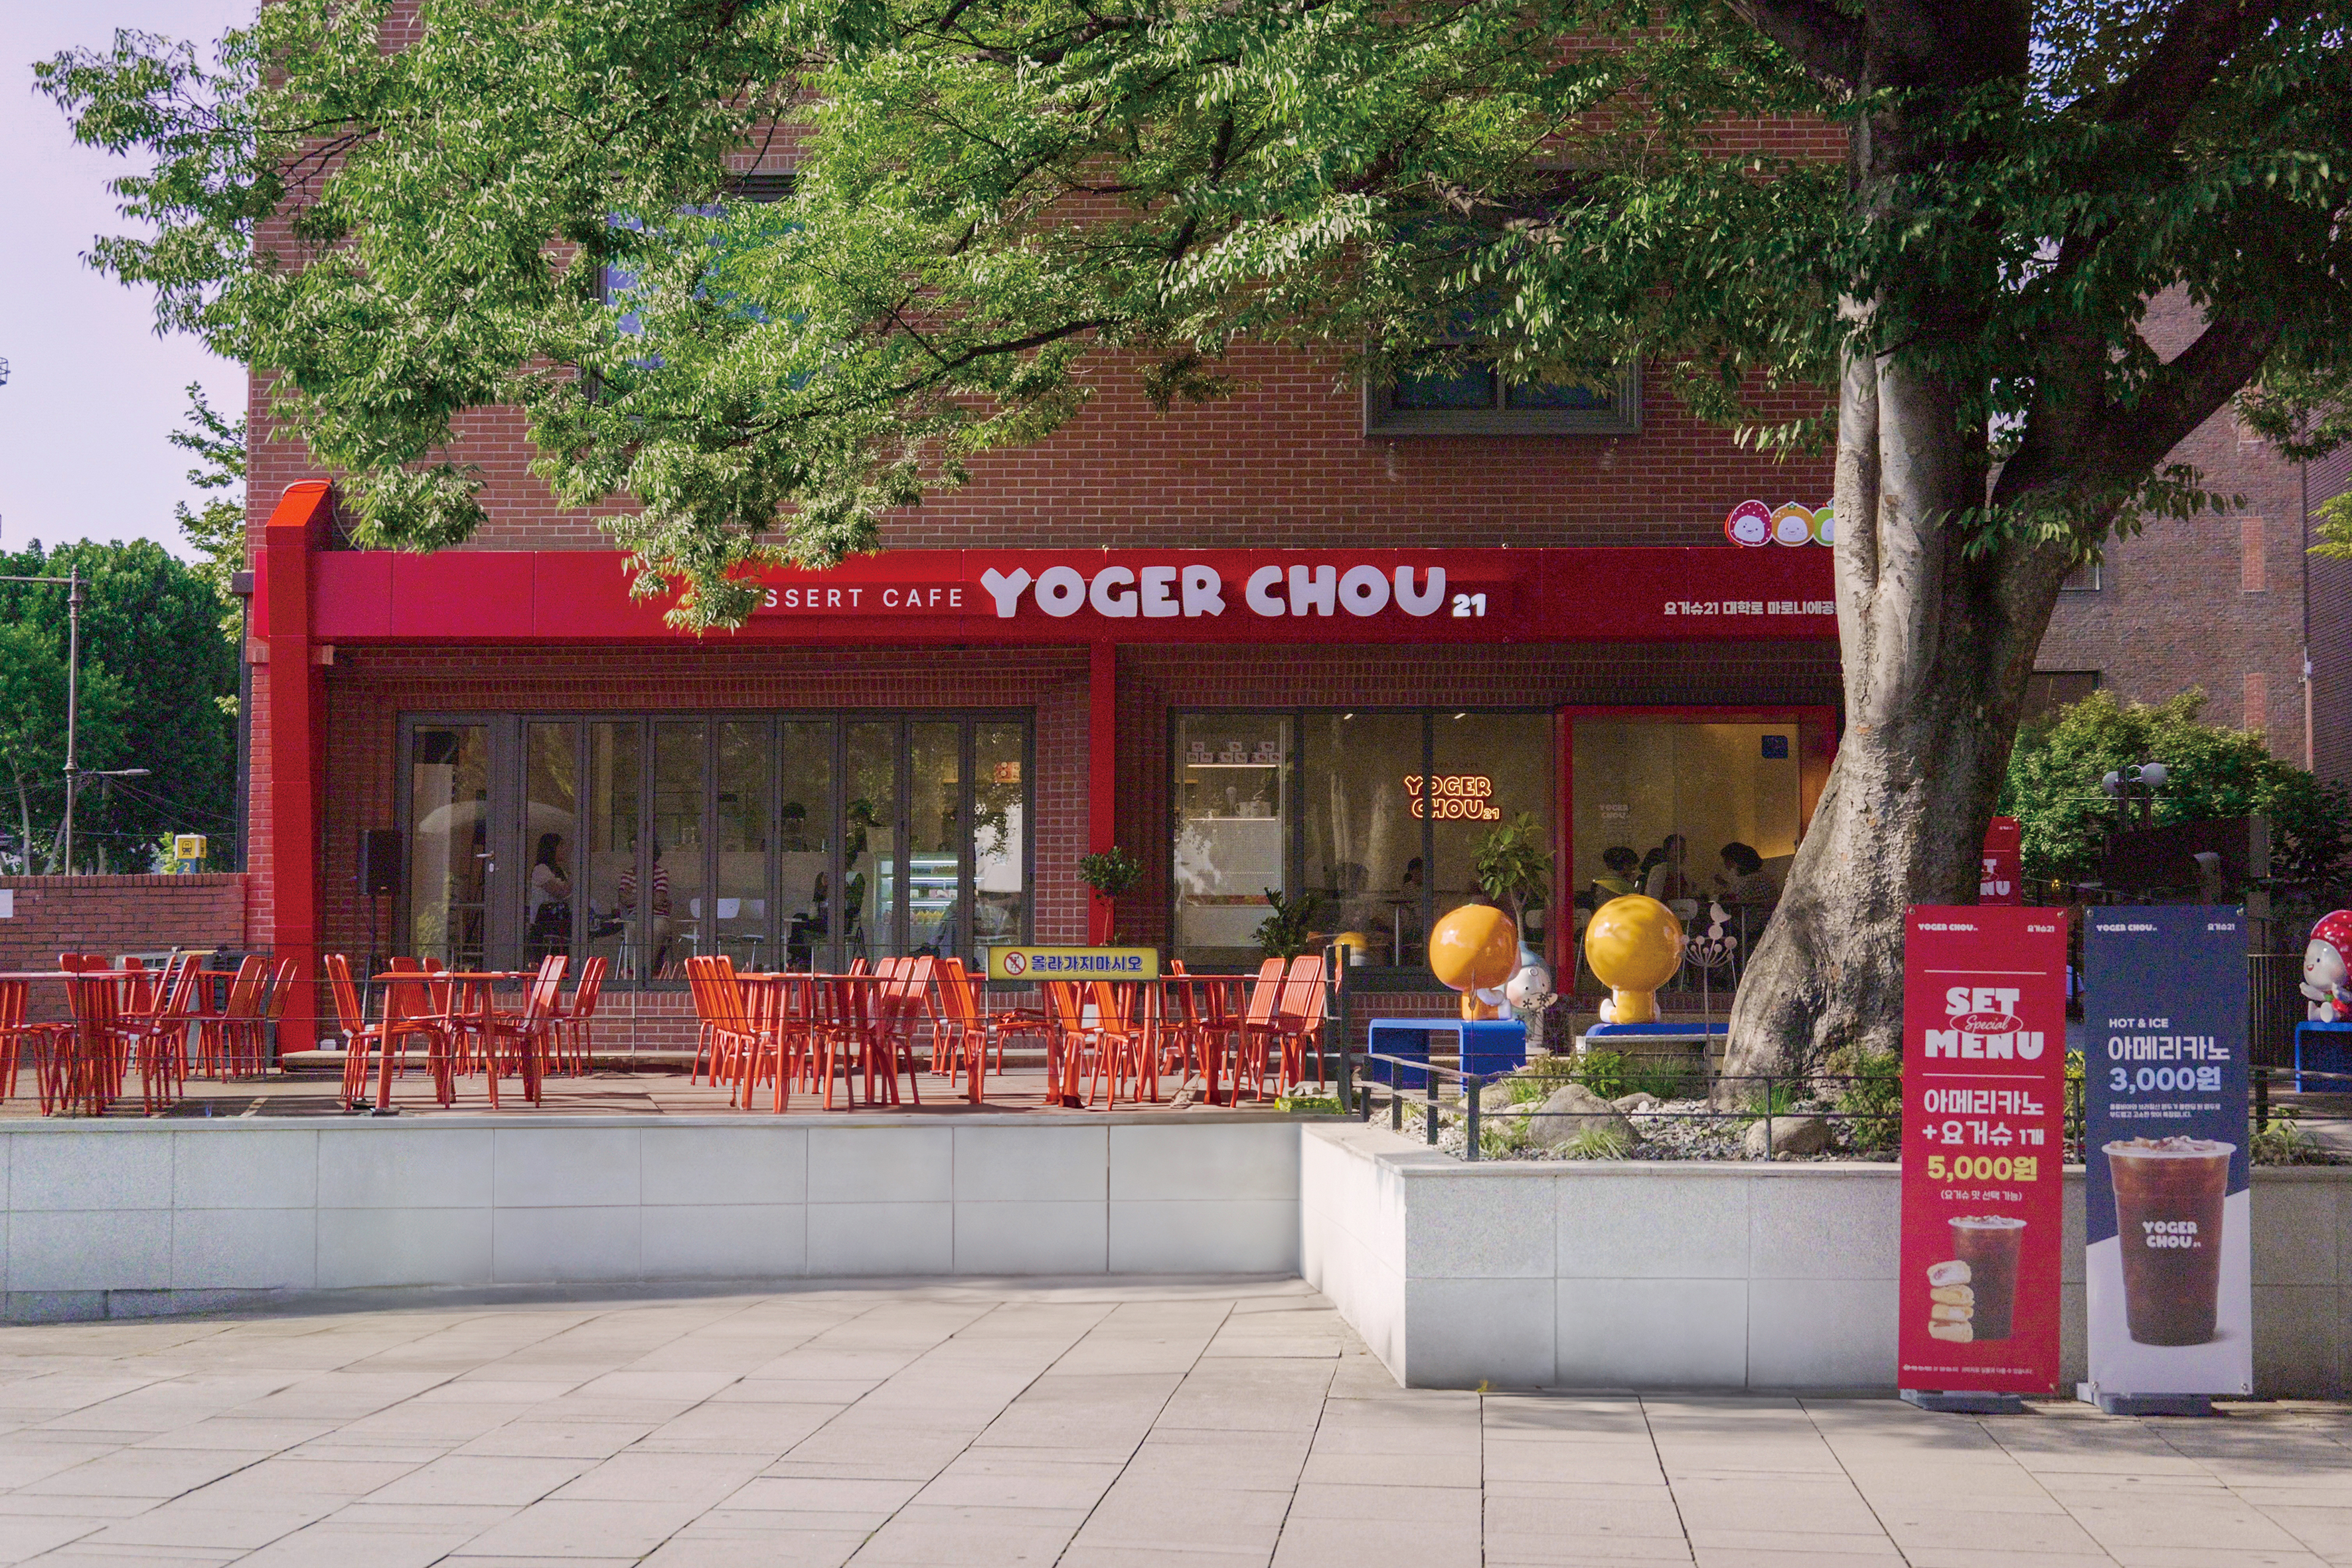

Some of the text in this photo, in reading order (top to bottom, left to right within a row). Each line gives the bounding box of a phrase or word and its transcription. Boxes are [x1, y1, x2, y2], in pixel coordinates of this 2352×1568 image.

[765, 589, 963, 607] SSERT CAFE
[980, 565, 1226, 617] YOGER
[1664, 601, 1838, 615] 요거슈21 대학로 마로니에공
[1404, 775, 1492, 797] YOGER
[184, 862, 191, 872] 2
[1032, 955, 1142, 971] 올라가지마시오
[1945, 986, 2020, 1016] SET
[1965, 1014, 2011, 1033] Special
[2109, 1018, 2169, 1028] HOT & ICE
[1925, 1029, 2044, 1059] MENU
[2108, 1036, 2231, 1060] 아메리카노
[2109, 1065, 2221, 1094] 3,000원
[1924, 1089, 2044, 1115] 아메리카노
[2019, 1129, 2045, 1145] 1개
[1927, 1155, 2037, 1182] 5,000원
[1941, 1190, 2023, 1202] (요거슈 맛 선택 가능)
[2142, 1221, 2198, 1235] YOGER
